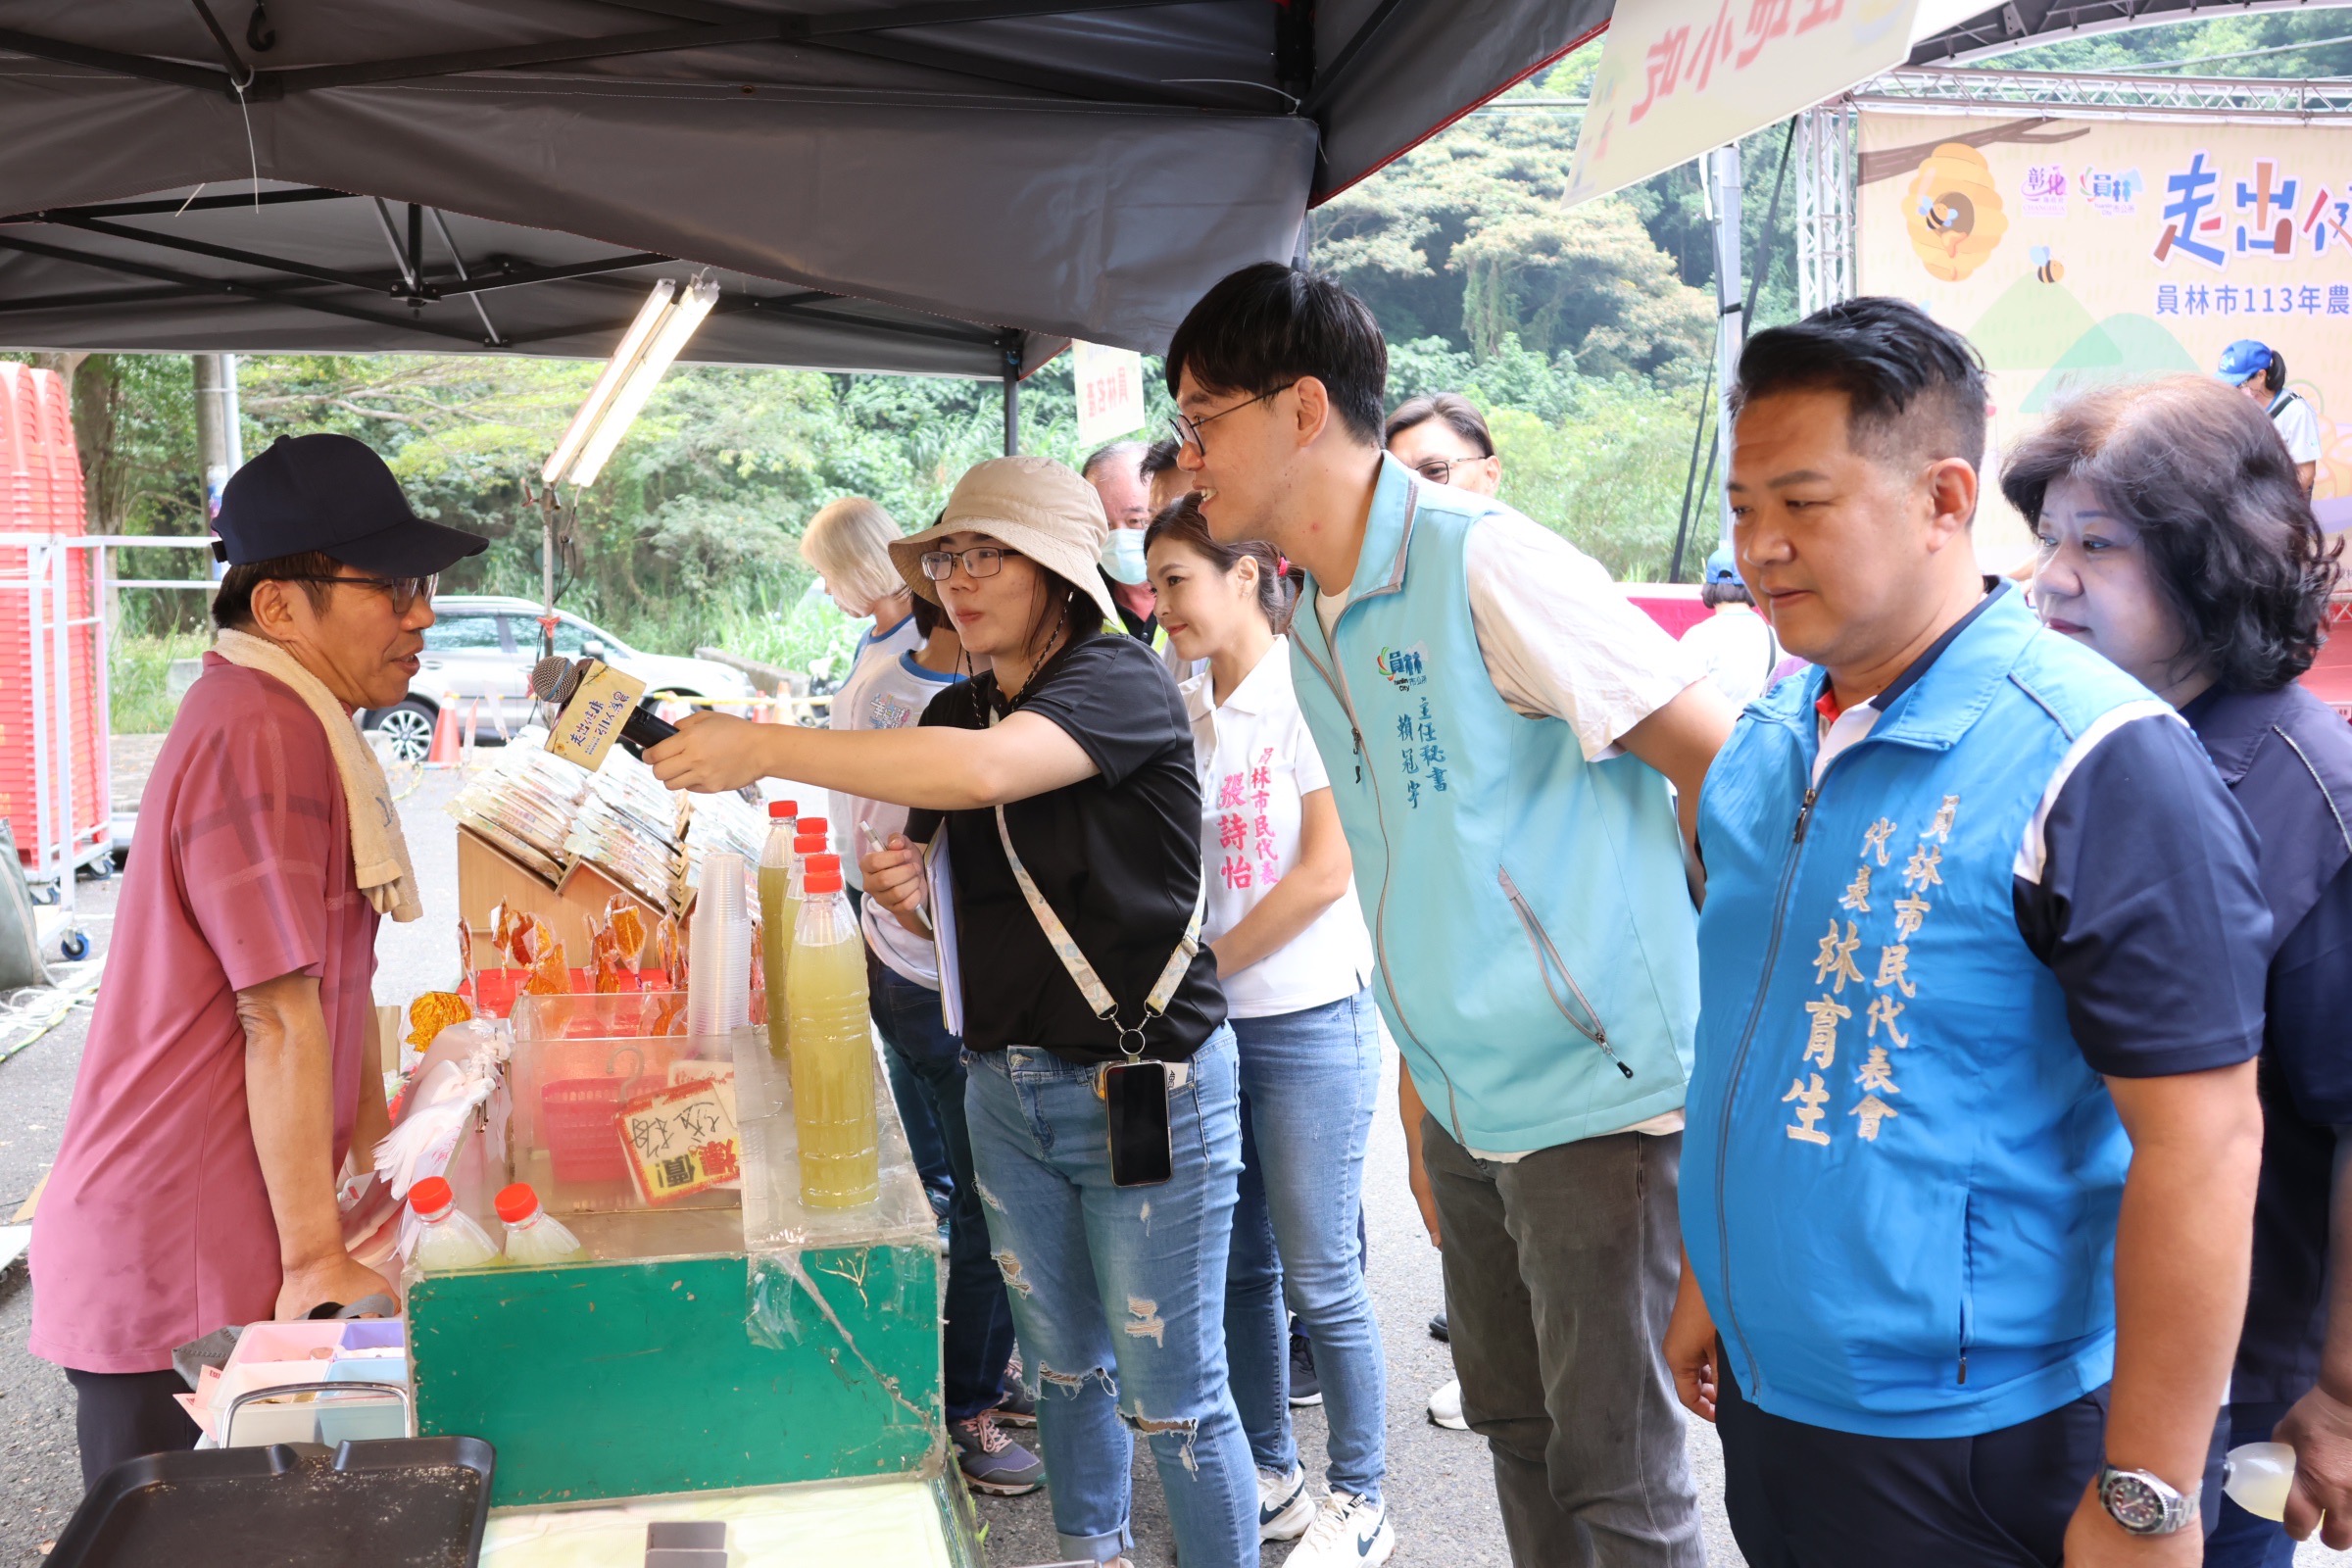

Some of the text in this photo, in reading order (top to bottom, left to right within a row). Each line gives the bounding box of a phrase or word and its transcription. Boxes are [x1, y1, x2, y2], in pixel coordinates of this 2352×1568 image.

[2156, 284, 2350, 315] 員林市113年農
[1417, 697, 1447, 792] 主任秘書
[1218, 771, 1252, 890] 張詩怡
[1250, 747, 1279, 886] 員林市民代表
[1847, 795, 1960, 1142] 員林市民代表會
